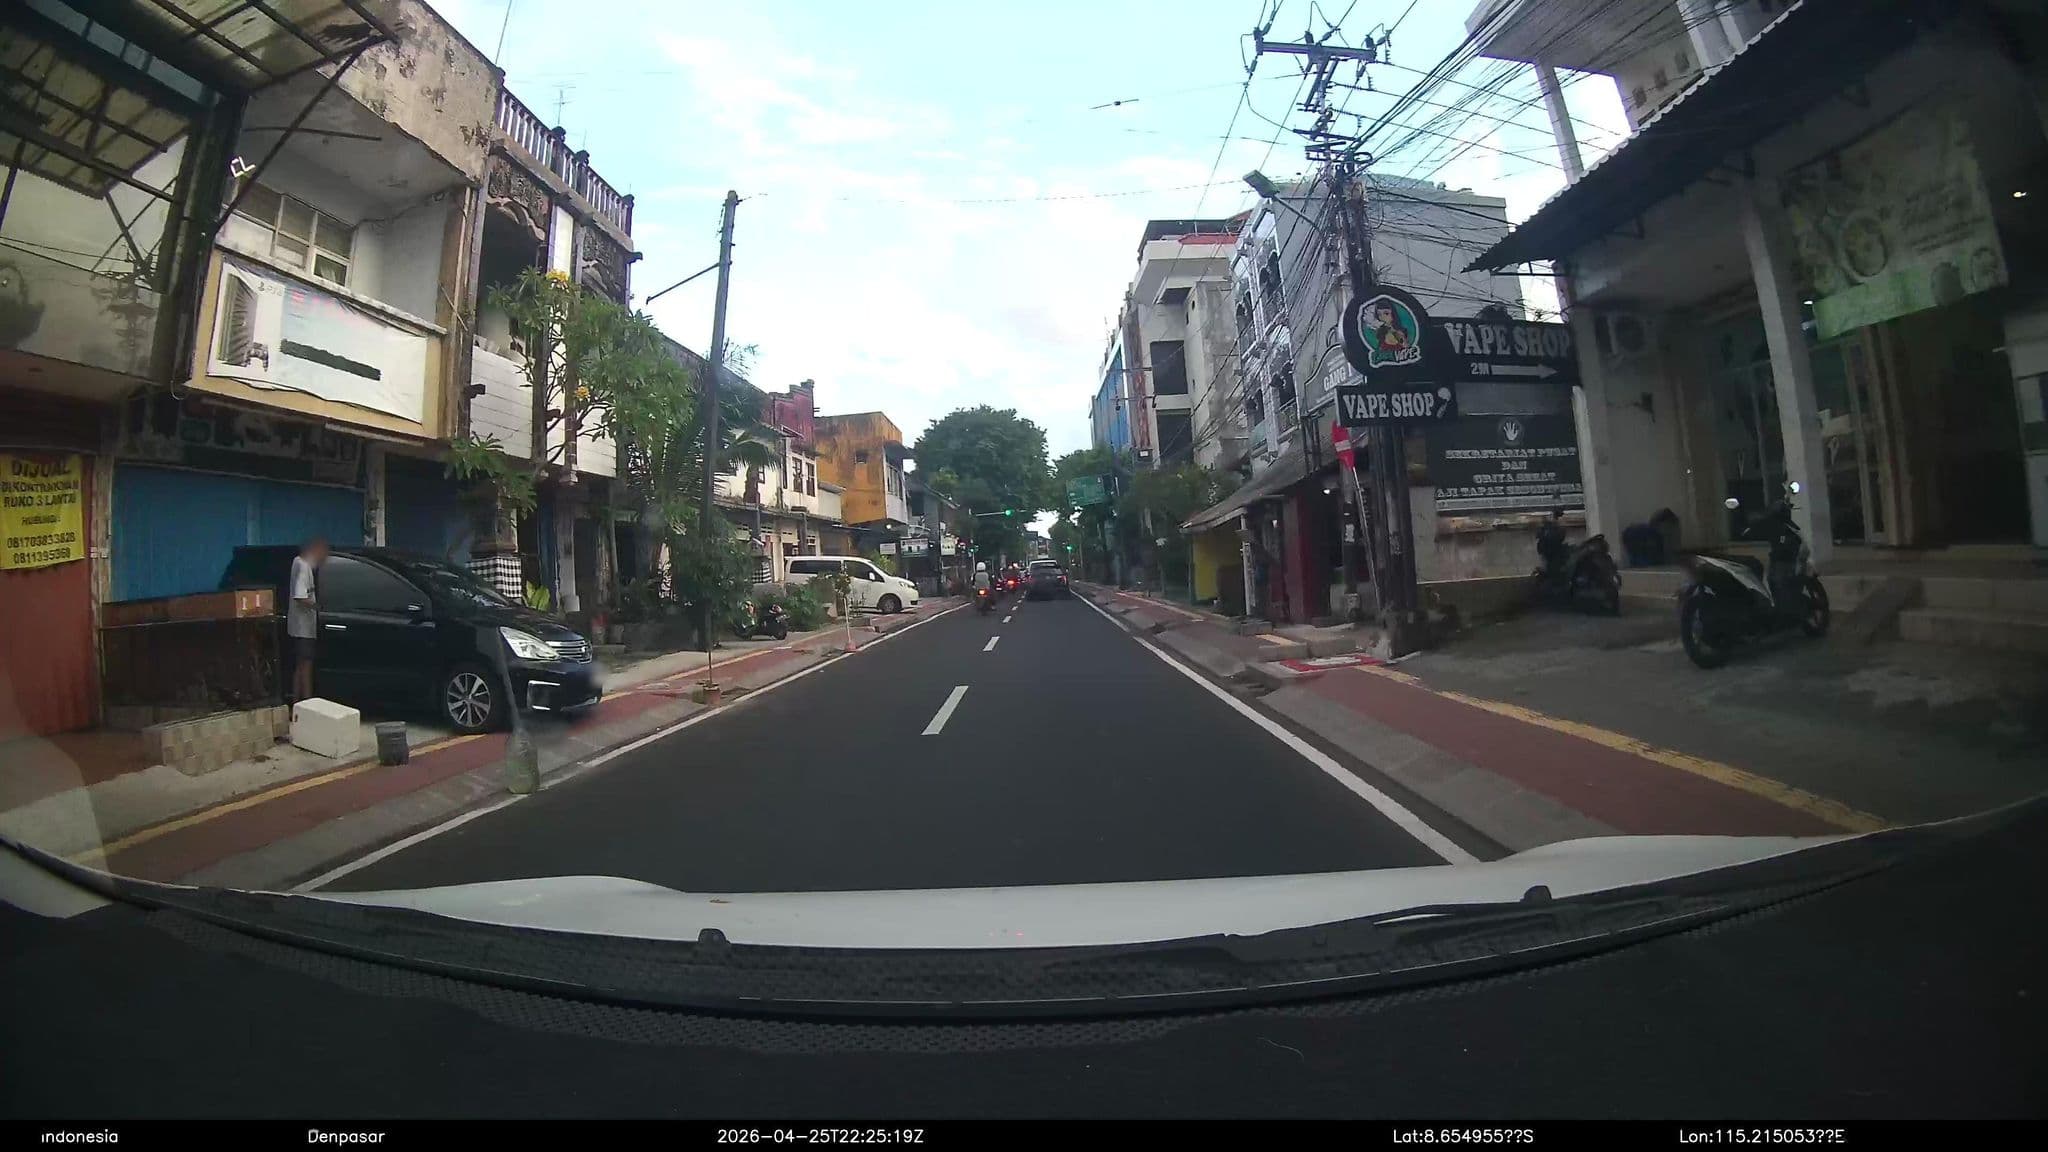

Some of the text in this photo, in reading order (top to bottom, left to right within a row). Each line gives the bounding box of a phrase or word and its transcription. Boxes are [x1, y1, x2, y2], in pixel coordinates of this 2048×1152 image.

[1444, 323, 1570, 357] VAPE SHOP
[1323, 366, 1346, 392] GANG
[1343, 393, 1389, 419] VAPE
[1391, 392, 1434, 417] SHOP
